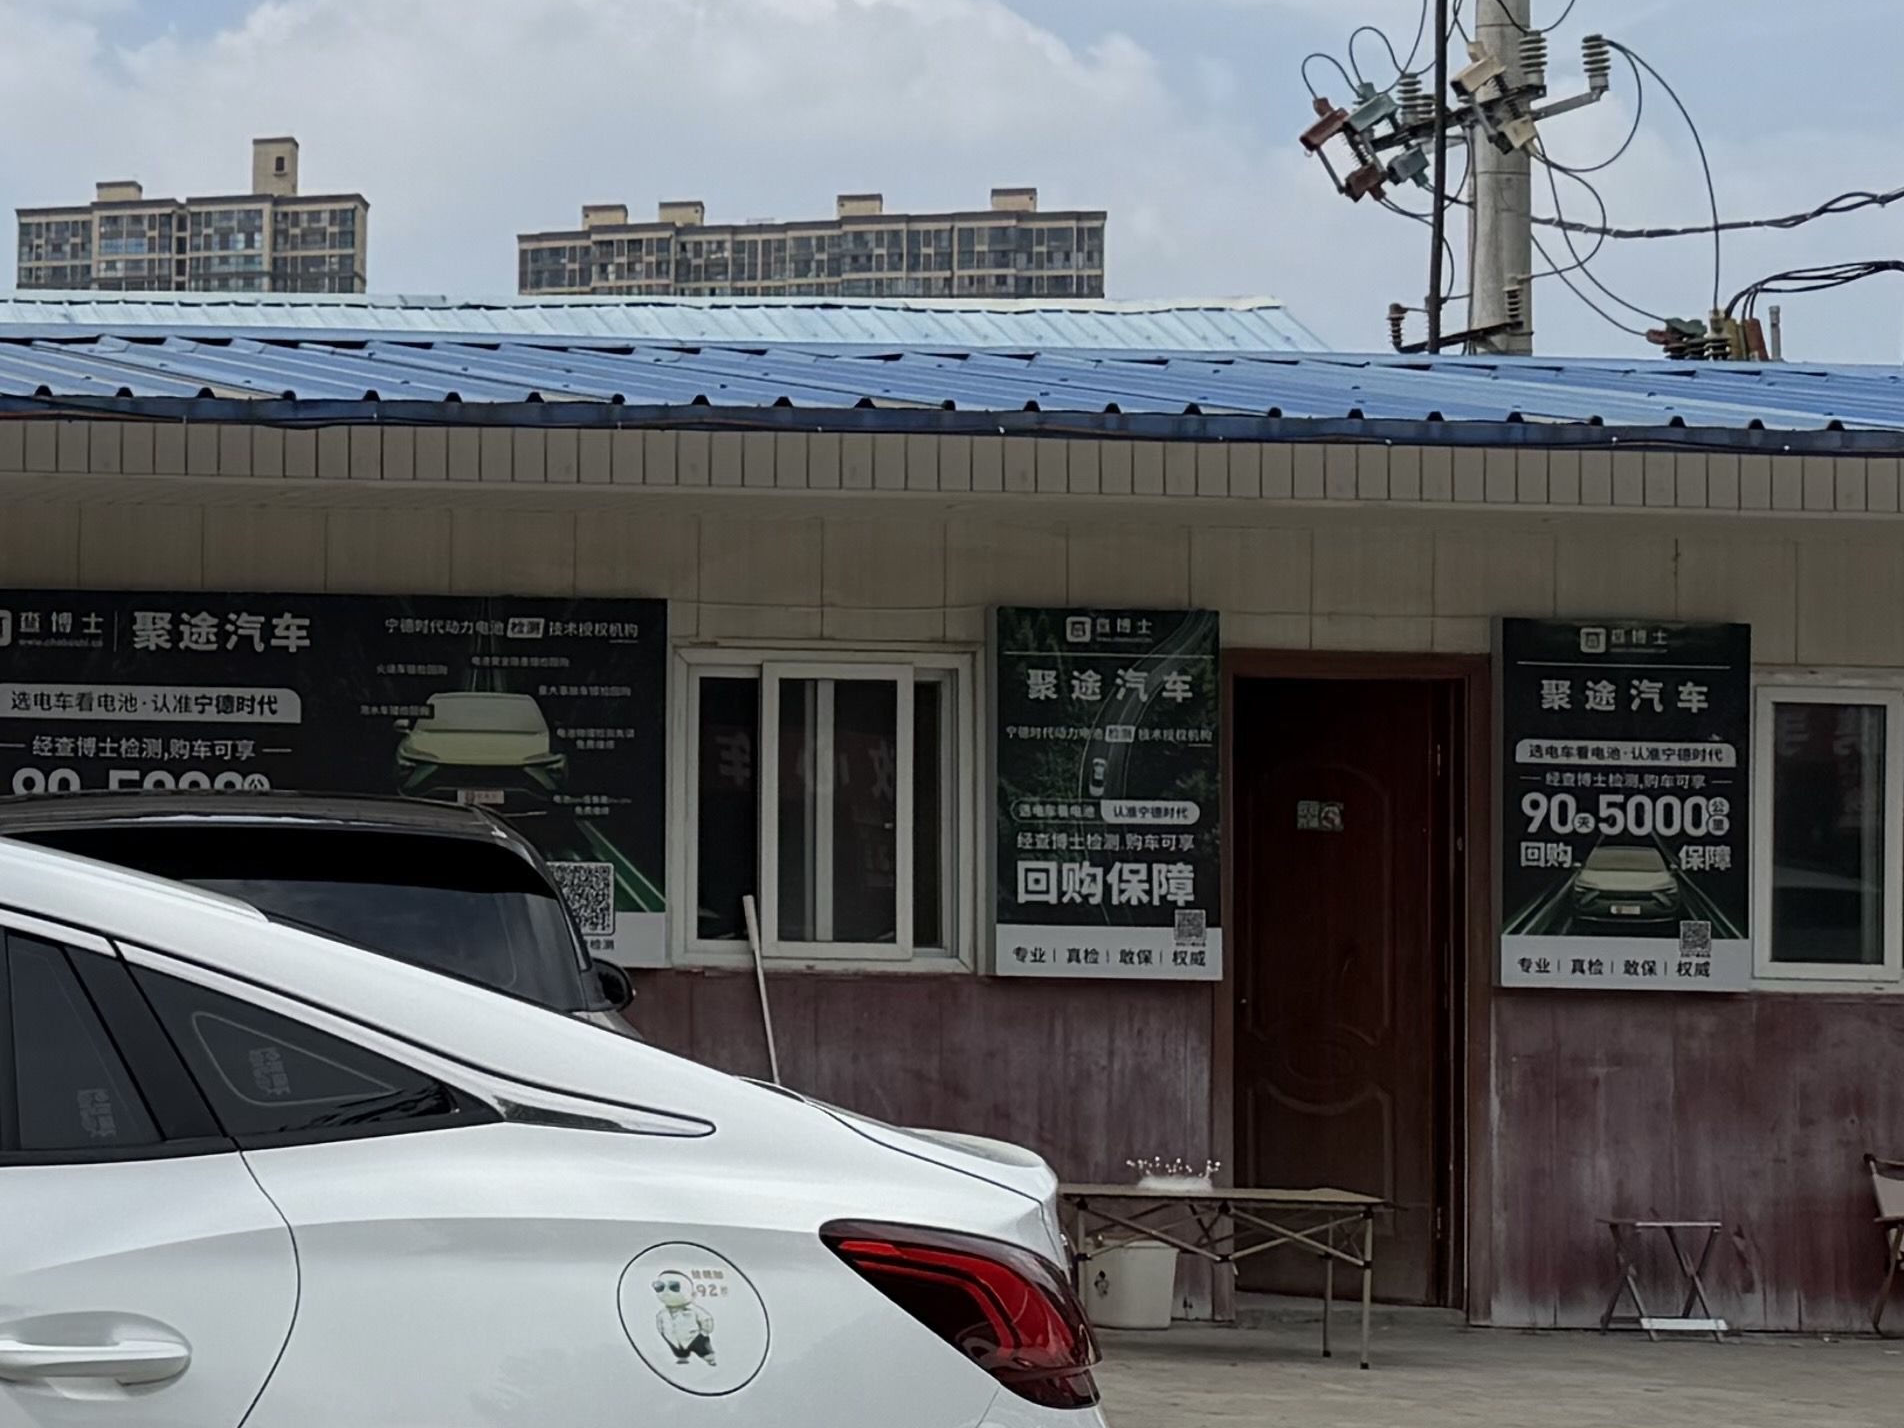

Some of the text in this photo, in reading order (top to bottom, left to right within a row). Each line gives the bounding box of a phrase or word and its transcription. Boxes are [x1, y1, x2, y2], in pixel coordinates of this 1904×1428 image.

[18, 611, 312, 653] 查博士 聚途汽车
[384, 618, 504, 637] 宁德时代动力电池
[1026, 668, 1194, 703] 聚途汽车
[1540, 678, 1710, 714] 聚途汽车
[11, 691, 279, 716] 选电车看电池·认准宁德时代
[1520, 840, 1732, 871] 回购 保障
[1016, 859, 1196, 908] 回购保障
